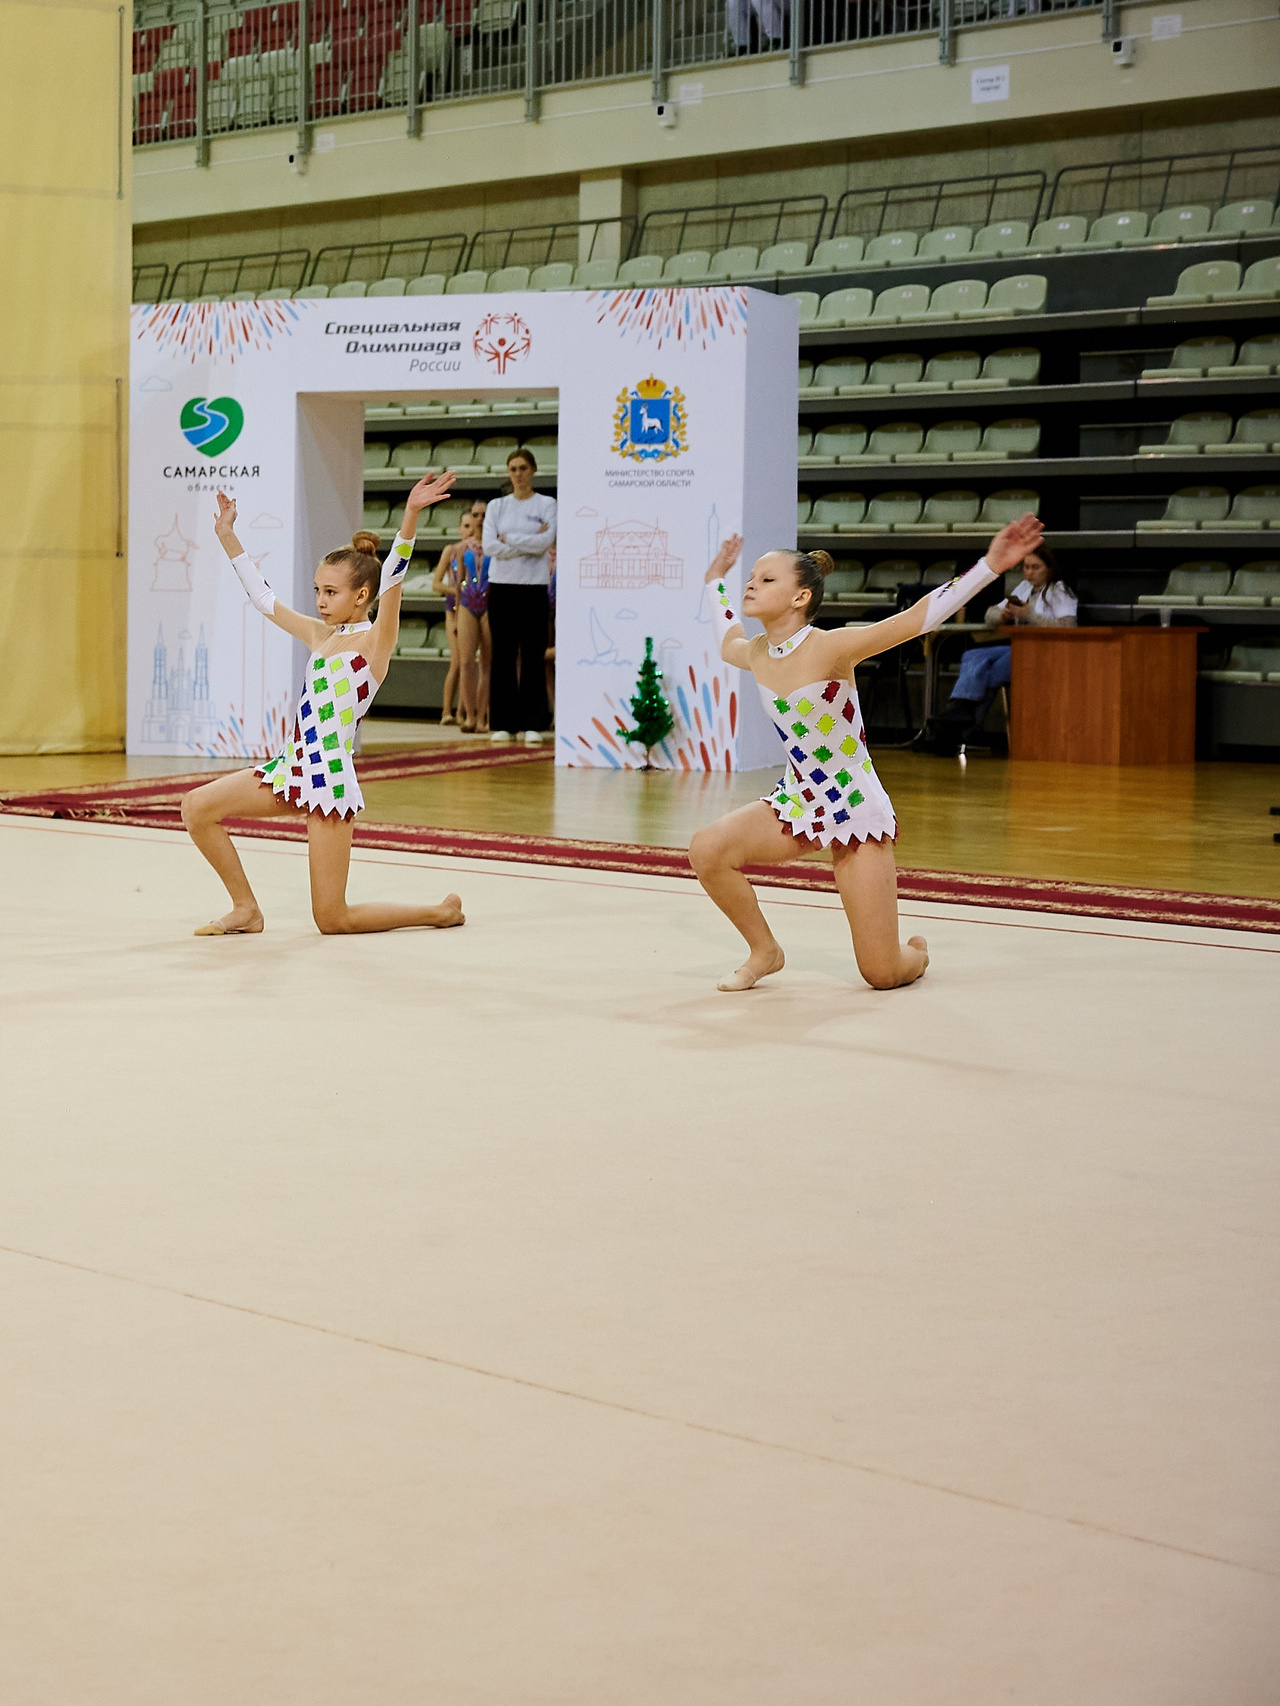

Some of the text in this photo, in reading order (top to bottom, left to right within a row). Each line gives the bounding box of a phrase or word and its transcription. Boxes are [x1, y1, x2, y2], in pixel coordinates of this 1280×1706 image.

[324, 321, 461, 335] Специальная
[345, 341, 461, 354] Олимпиада
[409, 359, 461, 372] России
[163, 465, 260, 478] САМАРСКАЯ
[605, 469, 695, 477] МИНИСТЕРСТВО СПОРТА
[187, 482, 235, 492] область
[608, 479, 691, 487] САМАРСКОЙ ОБЛАСТИ
